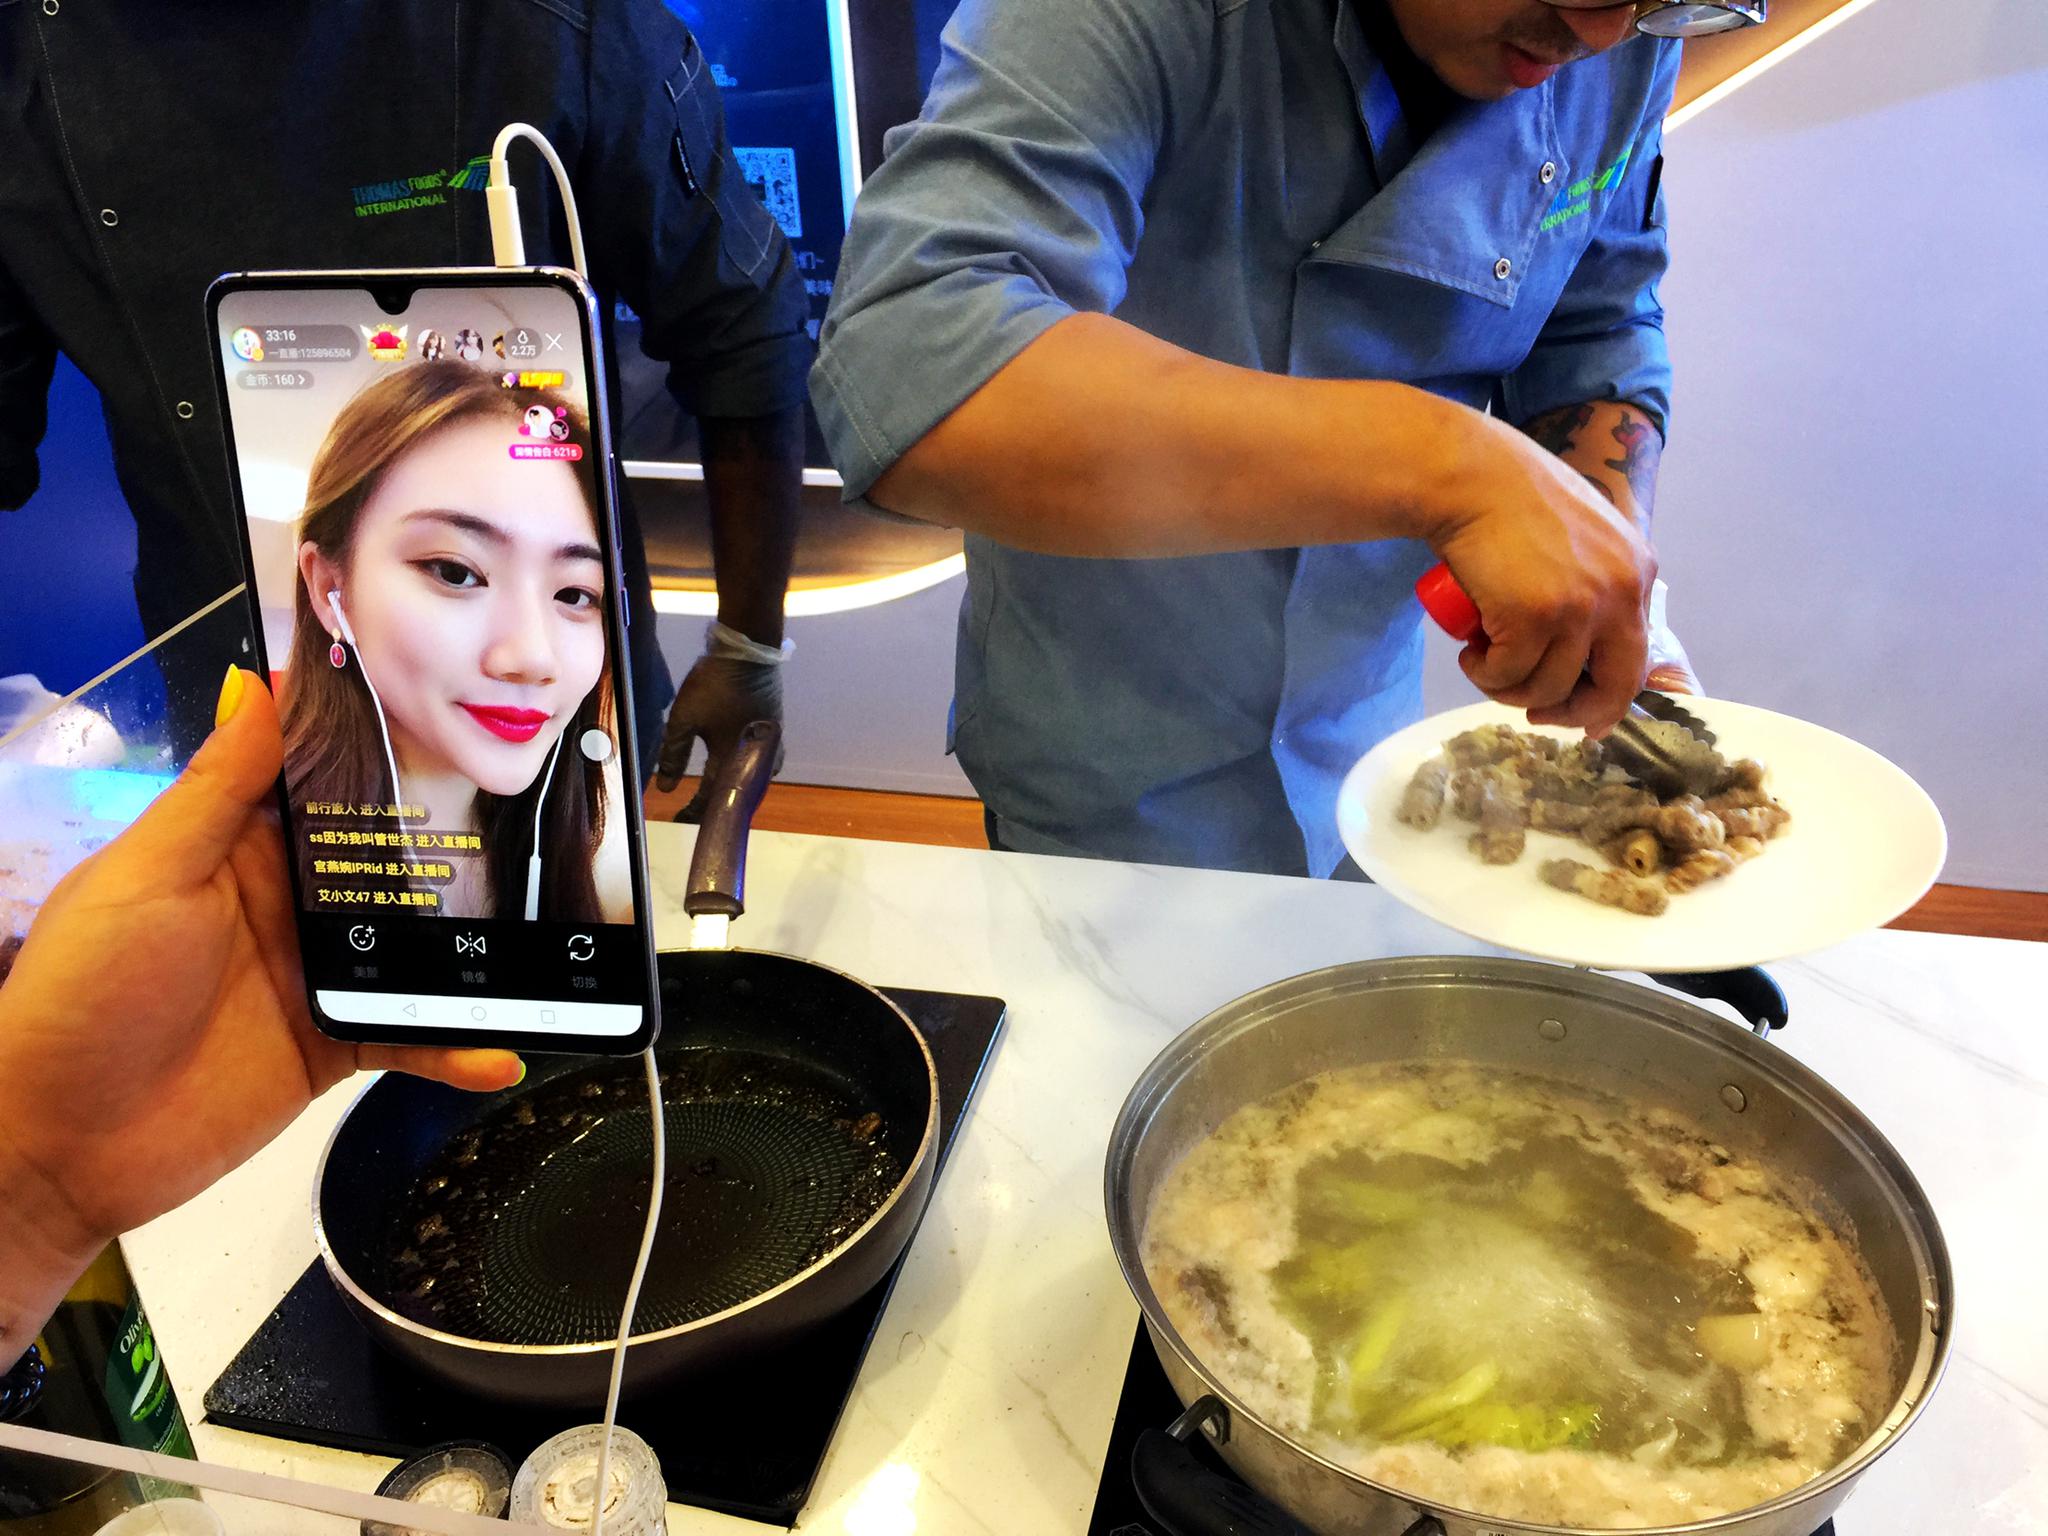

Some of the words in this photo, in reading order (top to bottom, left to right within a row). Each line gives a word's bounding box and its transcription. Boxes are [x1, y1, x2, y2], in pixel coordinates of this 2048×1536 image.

[355, 193, 447, 217] INTERNATIONAL
[265, 329, 297, 341] 33:16
[511, 344, 536, 356] 2.2万
[274, 374, 295, 385] 160
[305, 801, 358, 815] 前行旅人
[360, 803, 425, 818] 进入直播间
[309, 831, 414, 847] ss因为我叫管世杰
[416, 834, 482, 850] 进入直播间
[385, 862, 451, 878] 进入直播间
[317, 888, 370, 903] 艾小文47
[373, 891, 438, 907] 进入直播间
[461, 970, 488, 984] 镜像
[572, 975, 598, 989] 切换
